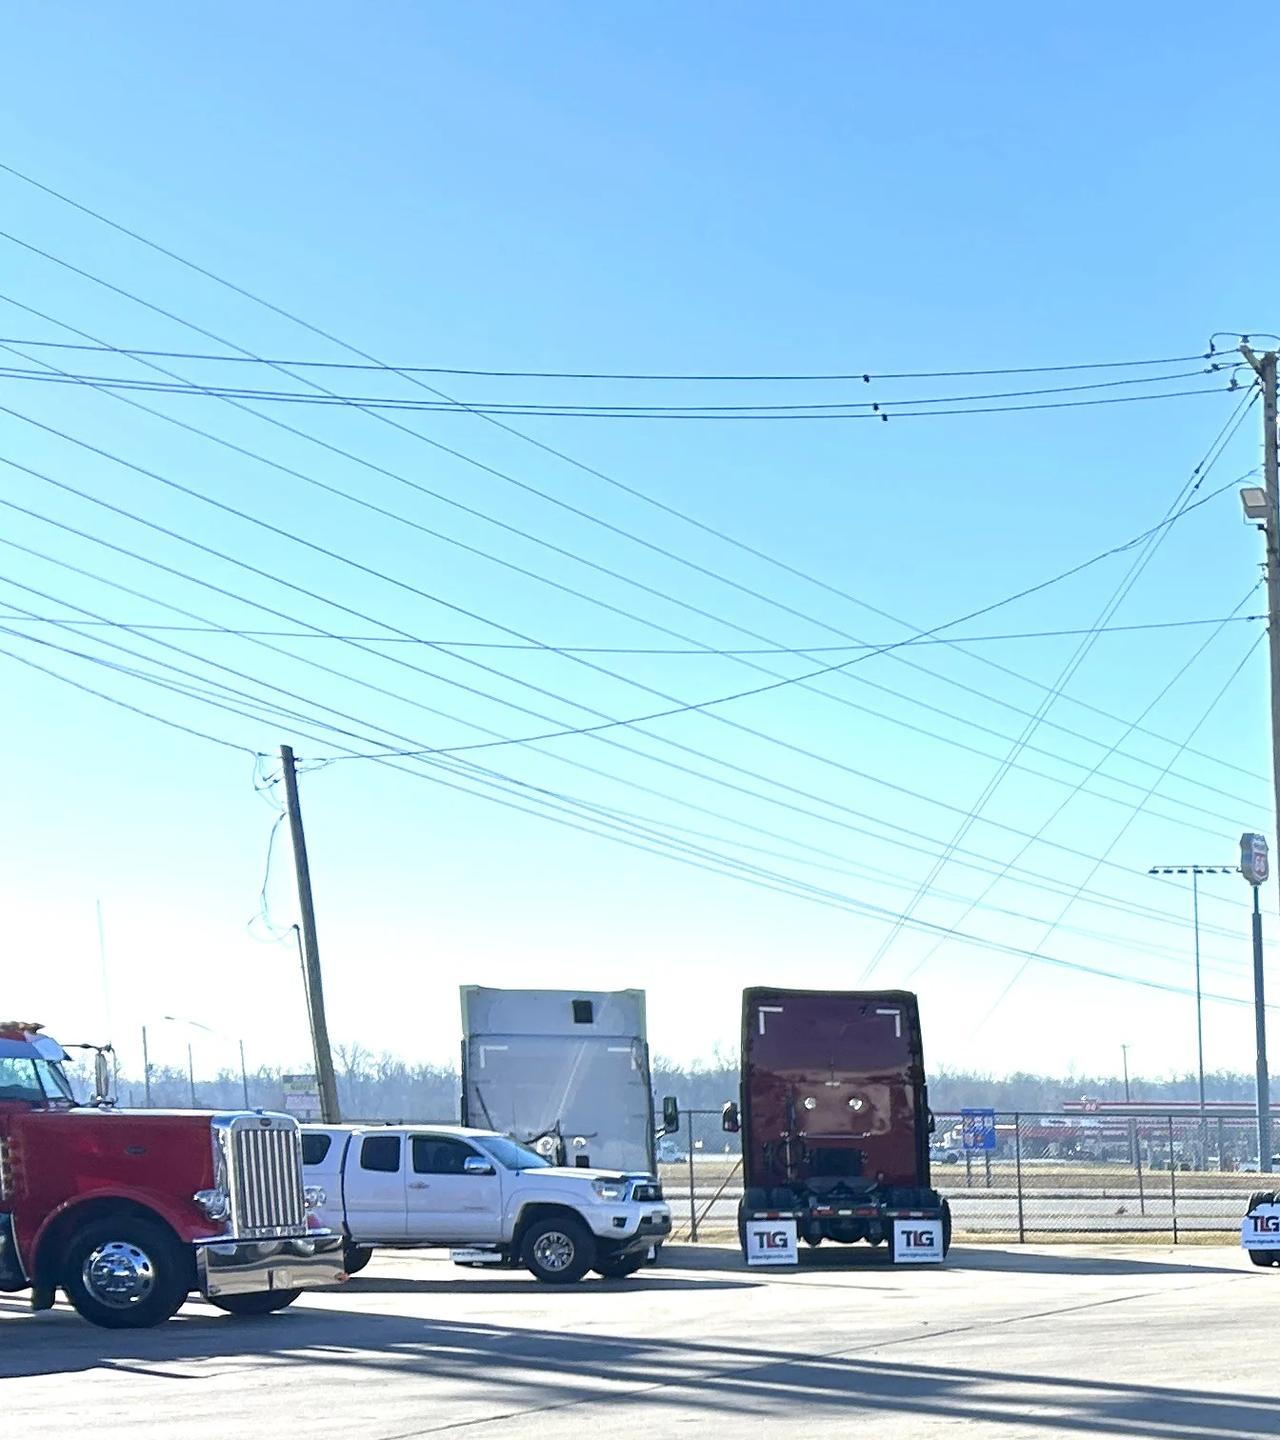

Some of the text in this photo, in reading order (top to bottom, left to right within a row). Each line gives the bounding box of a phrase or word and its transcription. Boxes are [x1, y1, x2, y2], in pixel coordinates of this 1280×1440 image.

[1248, 1215, 1280, 1232] TLG
[753, 1231, 788, 1249] TLG
[900, 1230, 934, 1247] TLG
